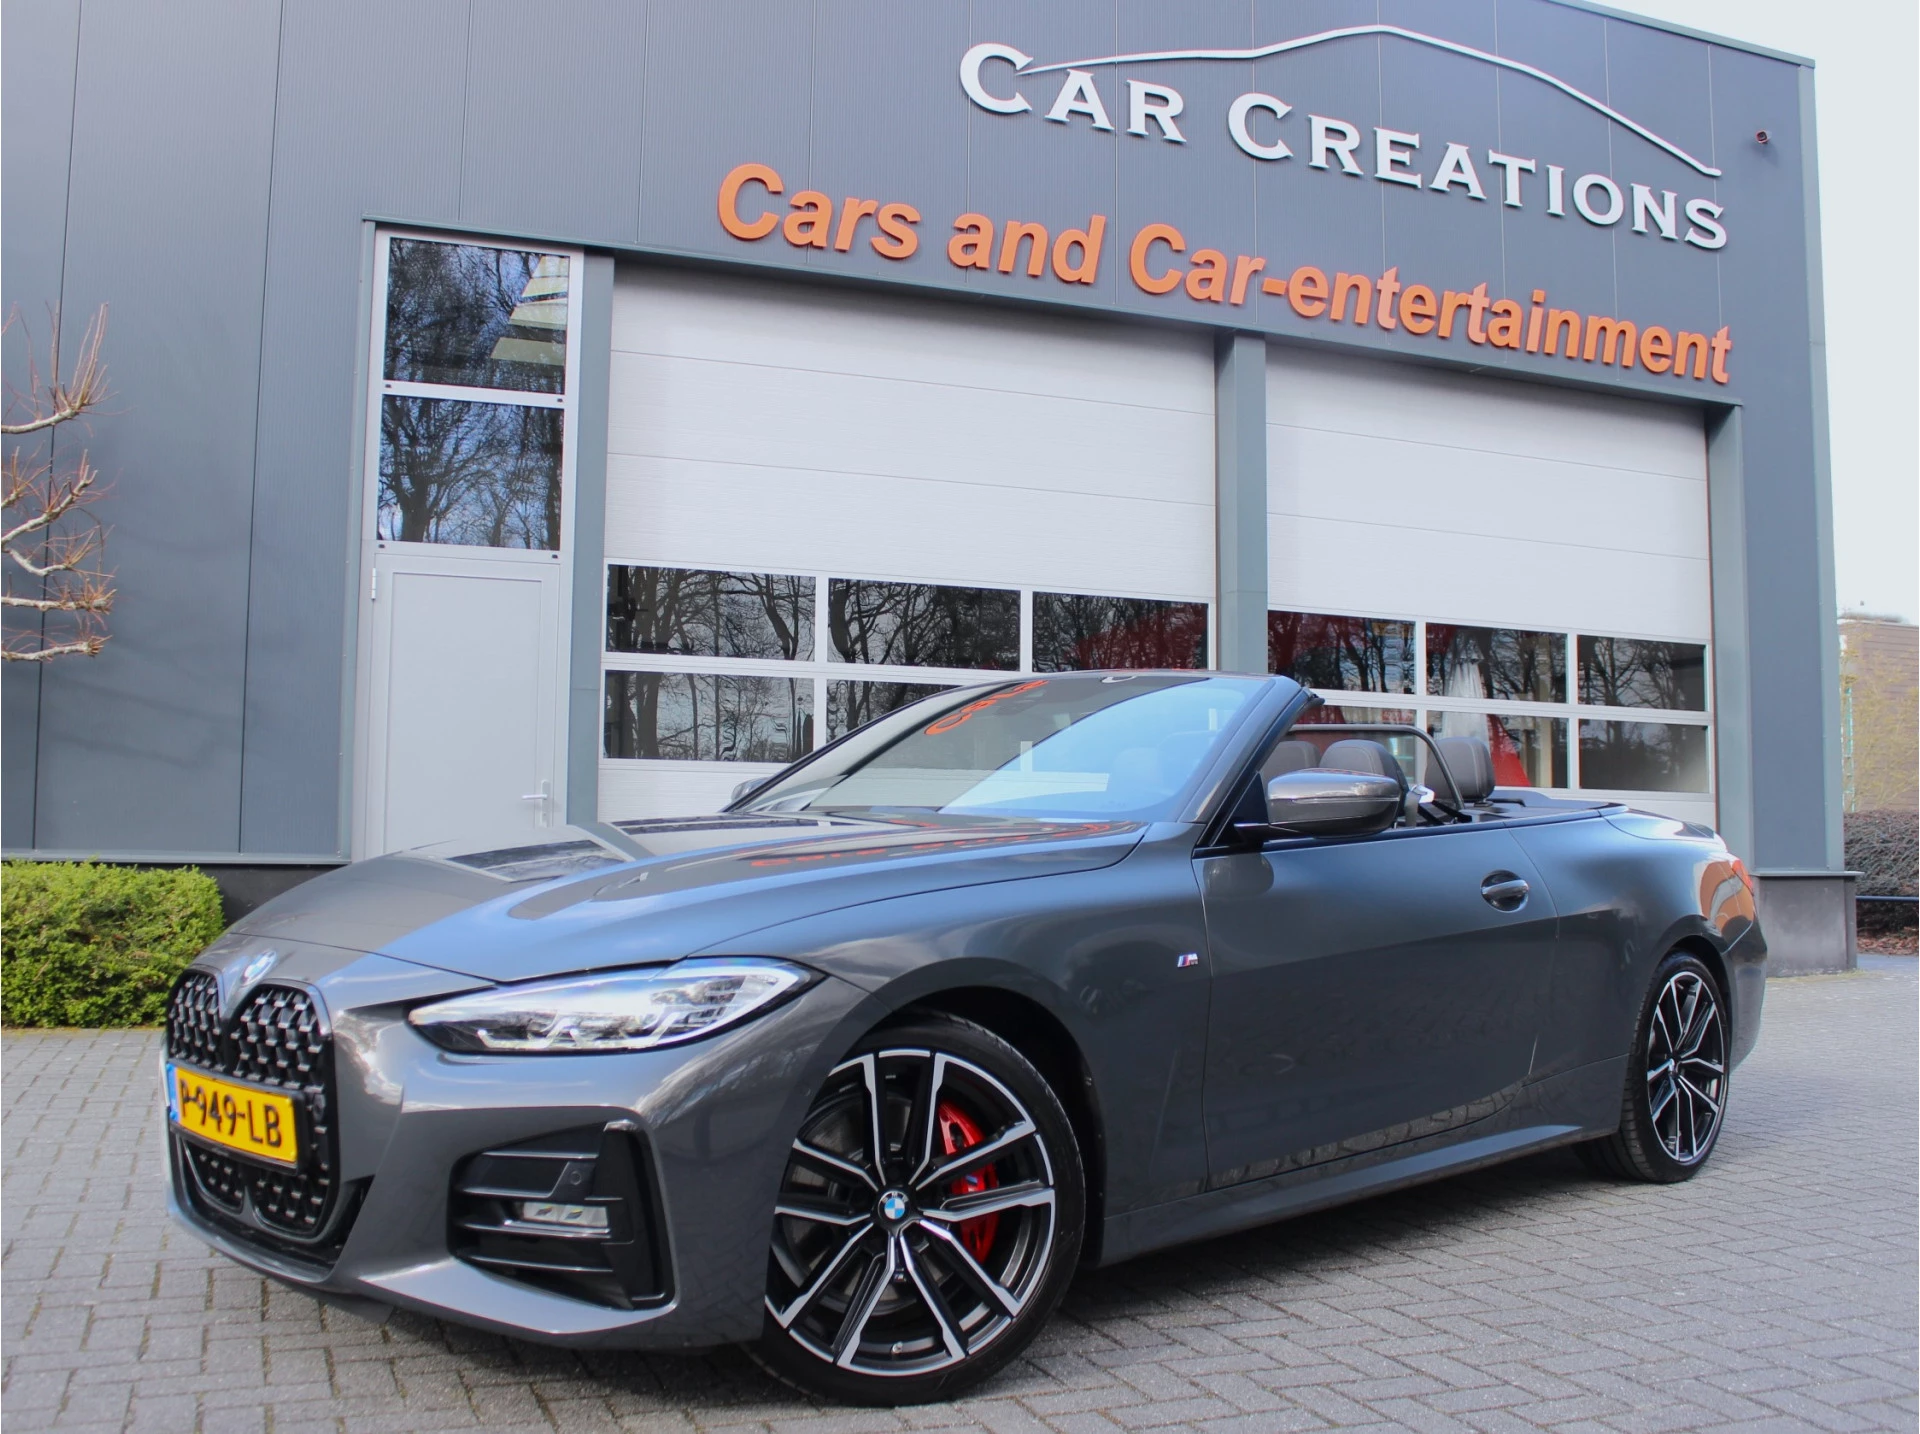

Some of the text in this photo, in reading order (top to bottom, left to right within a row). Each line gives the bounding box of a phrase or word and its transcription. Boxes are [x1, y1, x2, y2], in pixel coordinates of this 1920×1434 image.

[960, 43, 1728, 250] CAR CREATIONS
[717, 163, 1733, 385] Cars and Car-entertainment
[180, 1078, 283, 1148] P-949-LB
